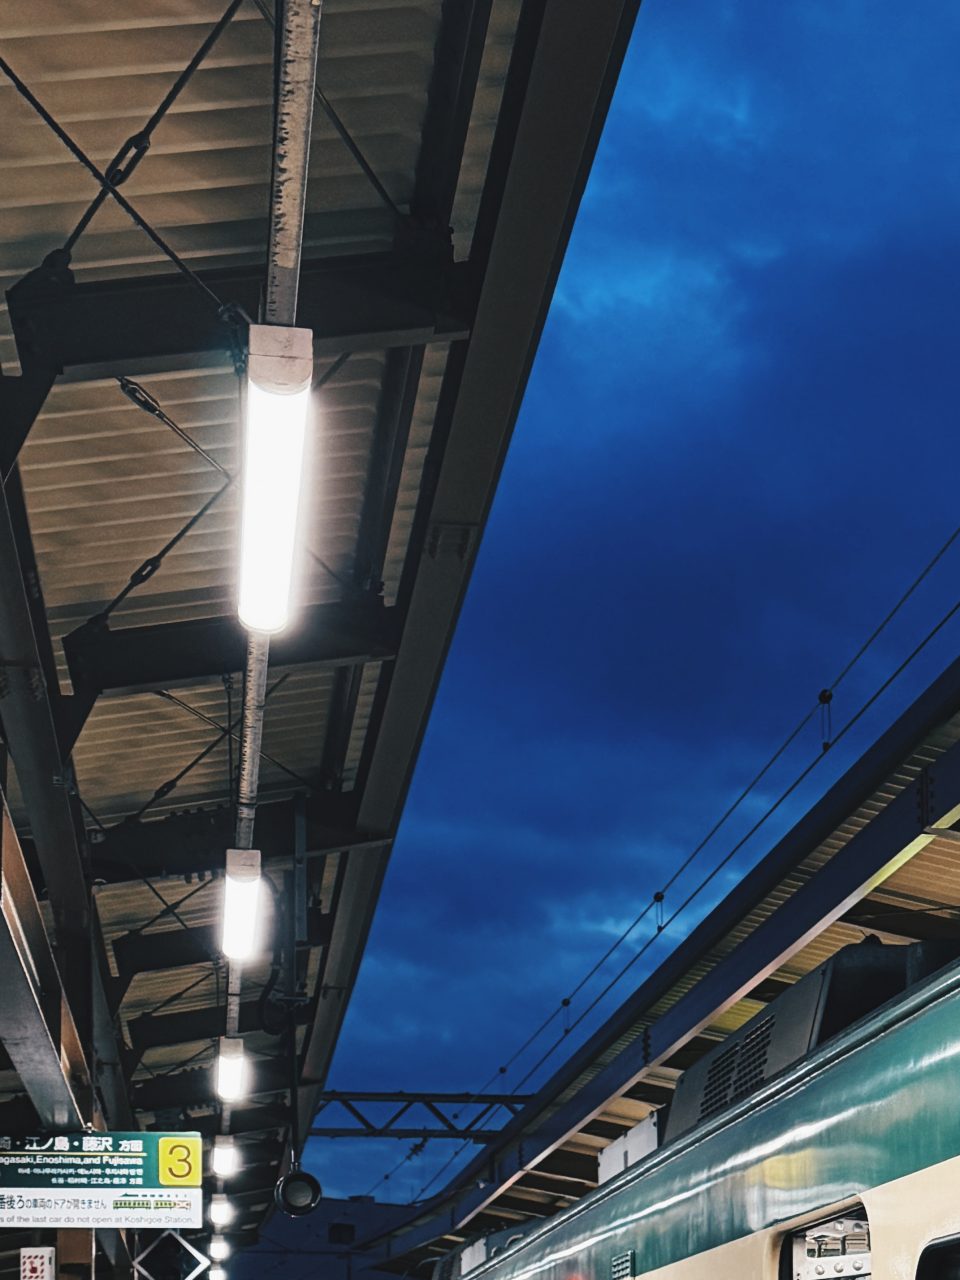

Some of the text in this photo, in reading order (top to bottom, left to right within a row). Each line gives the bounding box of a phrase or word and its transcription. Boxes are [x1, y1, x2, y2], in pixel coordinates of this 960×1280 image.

[168, 1144, 192, 1178] 3
[7, 1215, 15, 1223] of
[92, 1217, 112, 1225] open
[125, 1216, 162, 1225] Koshigoe
